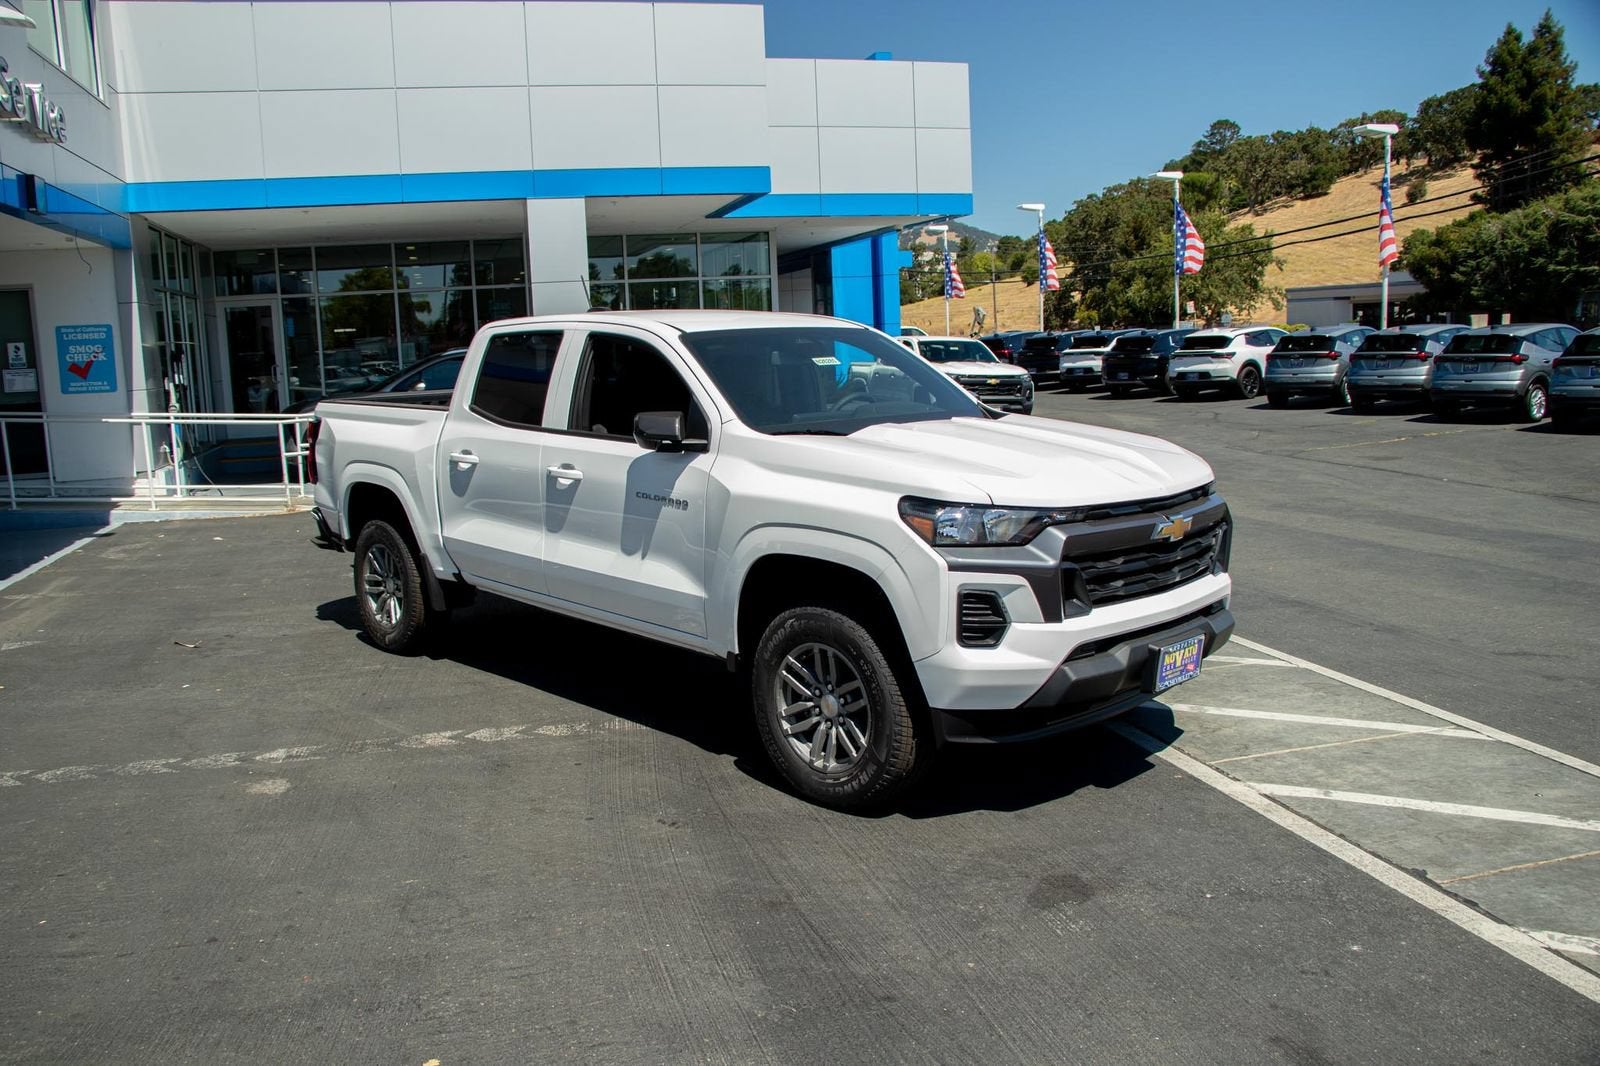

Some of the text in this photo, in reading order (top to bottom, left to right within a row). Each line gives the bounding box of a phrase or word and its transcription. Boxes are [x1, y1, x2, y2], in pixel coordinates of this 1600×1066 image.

[63, 332, 106, 340] LICENSED
[68, 344, 104, 354] SMOG
[65, 352, 108, 362] CHECK
